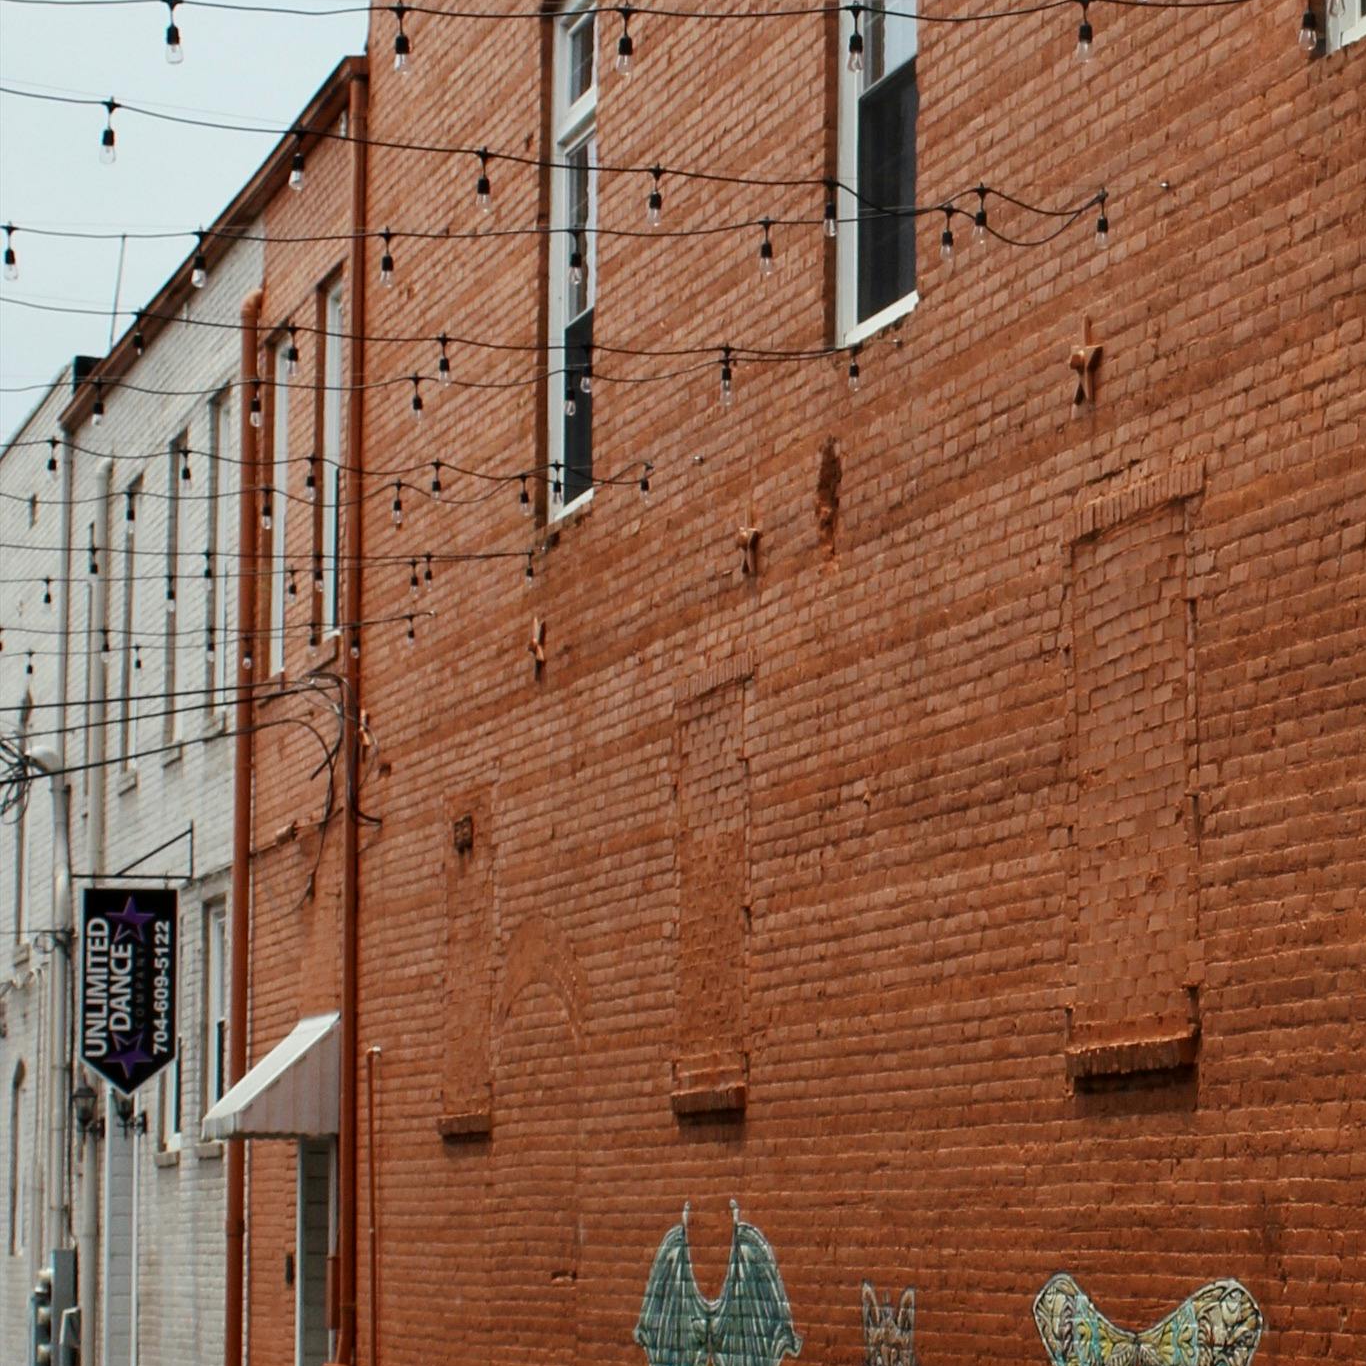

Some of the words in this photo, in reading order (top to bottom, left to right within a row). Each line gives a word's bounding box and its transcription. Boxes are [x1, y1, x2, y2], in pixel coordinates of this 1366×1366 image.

[85, 916, 110, 1058] UNLIMITED
[109, 942, 133, 1032] DANCE
[135, 946, 145, 1029] COMPANY
[153, 920, 170, 1054] 704-609-5122
